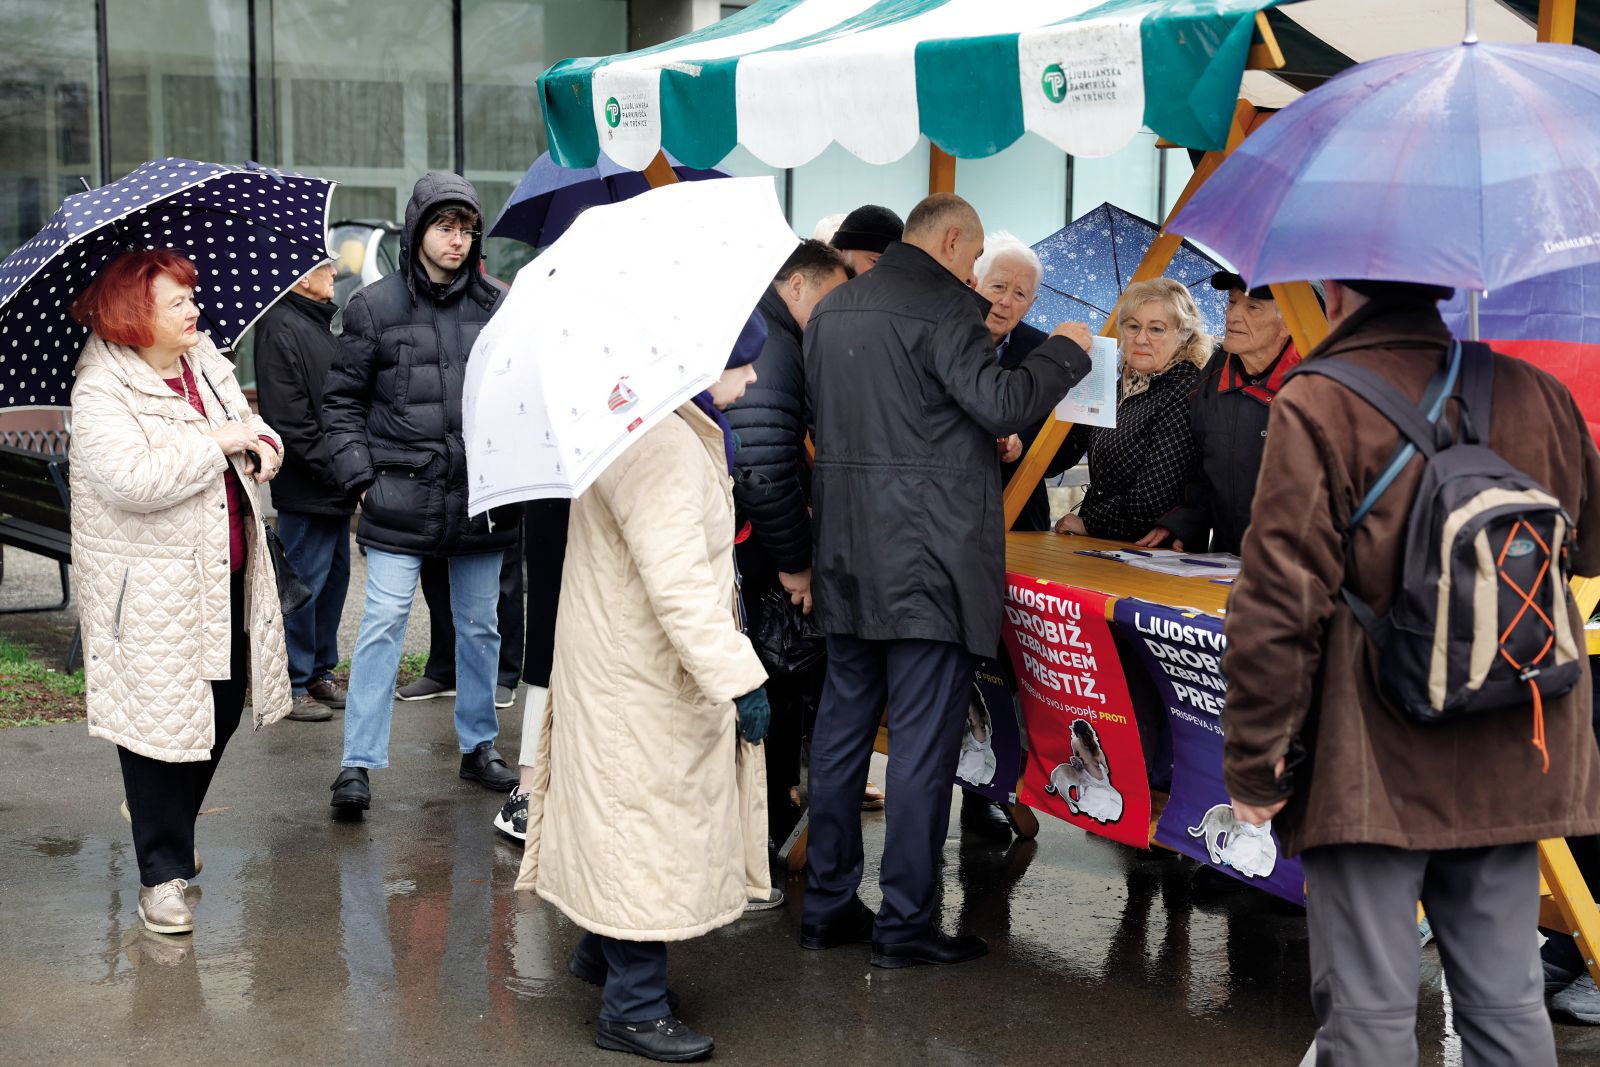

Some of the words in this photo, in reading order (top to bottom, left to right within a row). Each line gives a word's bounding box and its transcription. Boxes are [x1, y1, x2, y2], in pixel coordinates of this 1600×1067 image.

[1072, 94, 1080, 102] IN
[1004, 585, 1081, 620] JUDSTVU
[1004, 604, 1092, 653] DROBIŽ,
[1015, 630, 1098, 671] IZBRANCEM
[1144, 638, 1220, 674] DROB
[982, 672, 1004, 687] PROTI
[1022, 652, 1106, 704] PRESTIŽ,
[1159, 661, 1227, 692] IZBRAN
[1099, 711, 1127, 724] PROTI
[1170, 707, 1213, 731] PRISPEVAJ
